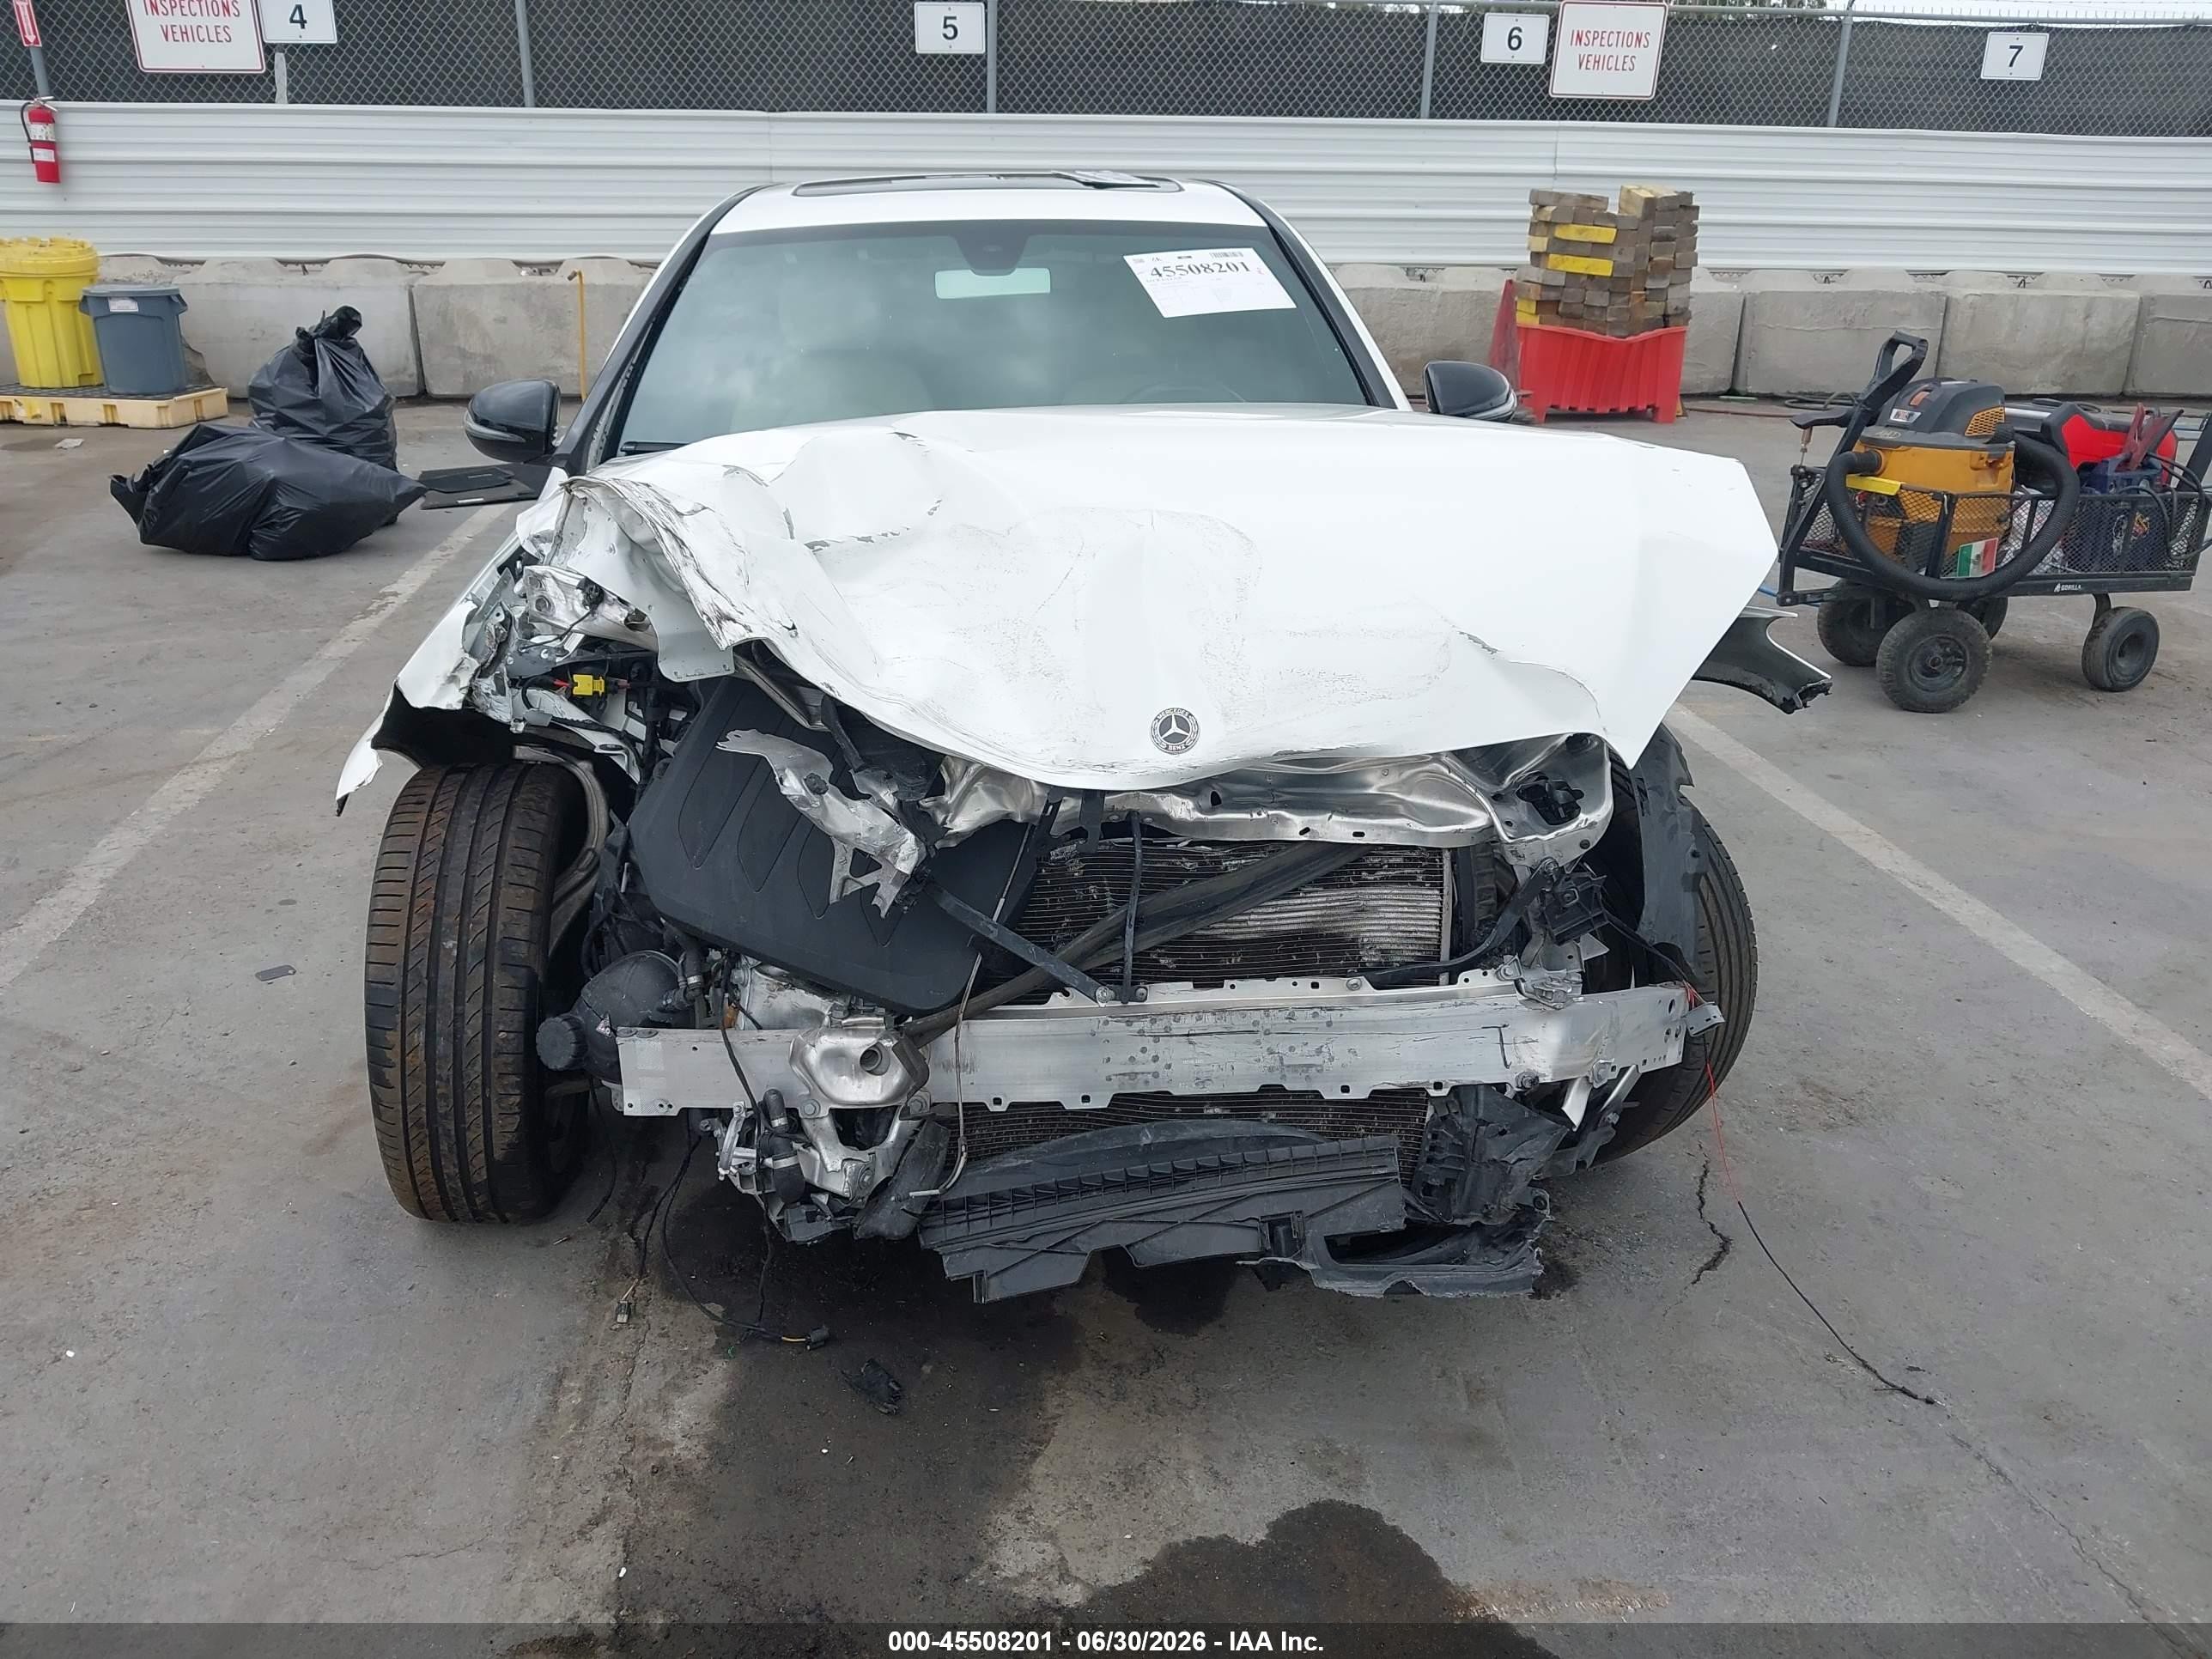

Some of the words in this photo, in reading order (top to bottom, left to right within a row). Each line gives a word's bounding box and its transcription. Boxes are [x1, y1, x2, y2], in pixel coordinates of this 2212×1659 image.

[143, 0, 241, 18] INSPECTIONS
[289, 4, 308, 30] 4
[160, 24, 233, 43] VEHICLES
[941, 15, 959, 41] 5
[1507, 26, 1524, 52] 6
[1570, 29, 1651, 49] INSPECTIONS
[1577, 53, 1637, 72] VEHICLES
[2008, 45, 2025, 68] 7
[1150, 261, 1251, 278] 45508201
